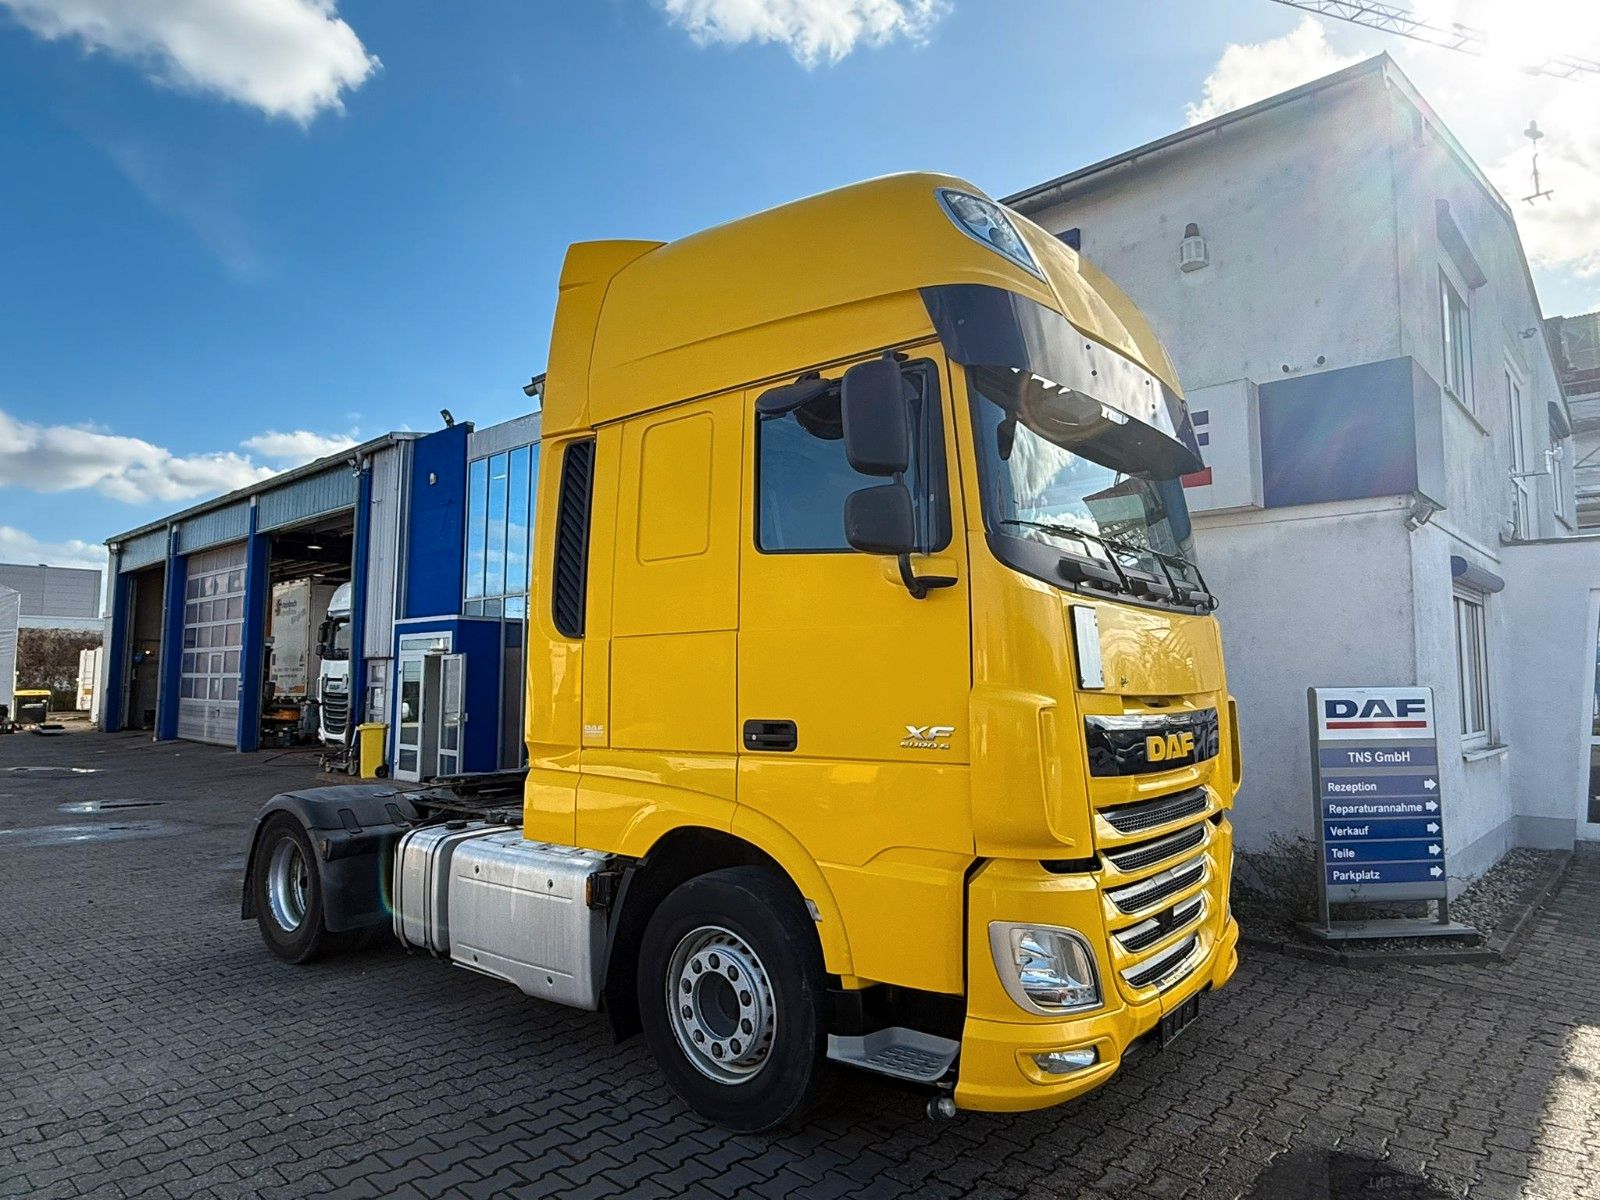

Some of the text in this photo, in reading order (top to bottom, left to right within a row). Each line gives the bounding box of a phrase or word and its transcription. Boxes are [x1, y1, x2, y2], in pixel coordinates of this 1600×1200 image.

[1325, 699, 1426, 718] DAF
[903, 725, 955, 741] XF
[1146, 731, 1194, 762] DAF
[1347, 751, 1411, 763] TNS GmbH
[1327, 782, 1377, 793] Rezeption
[1329, 803, 1423, 815] Reparaturannahme
[1330, 826, 1369, 836] Verkauf
[1331, 848, 1355, 858] Teile
[1333, 870, 1380, 881] Parkplatz
